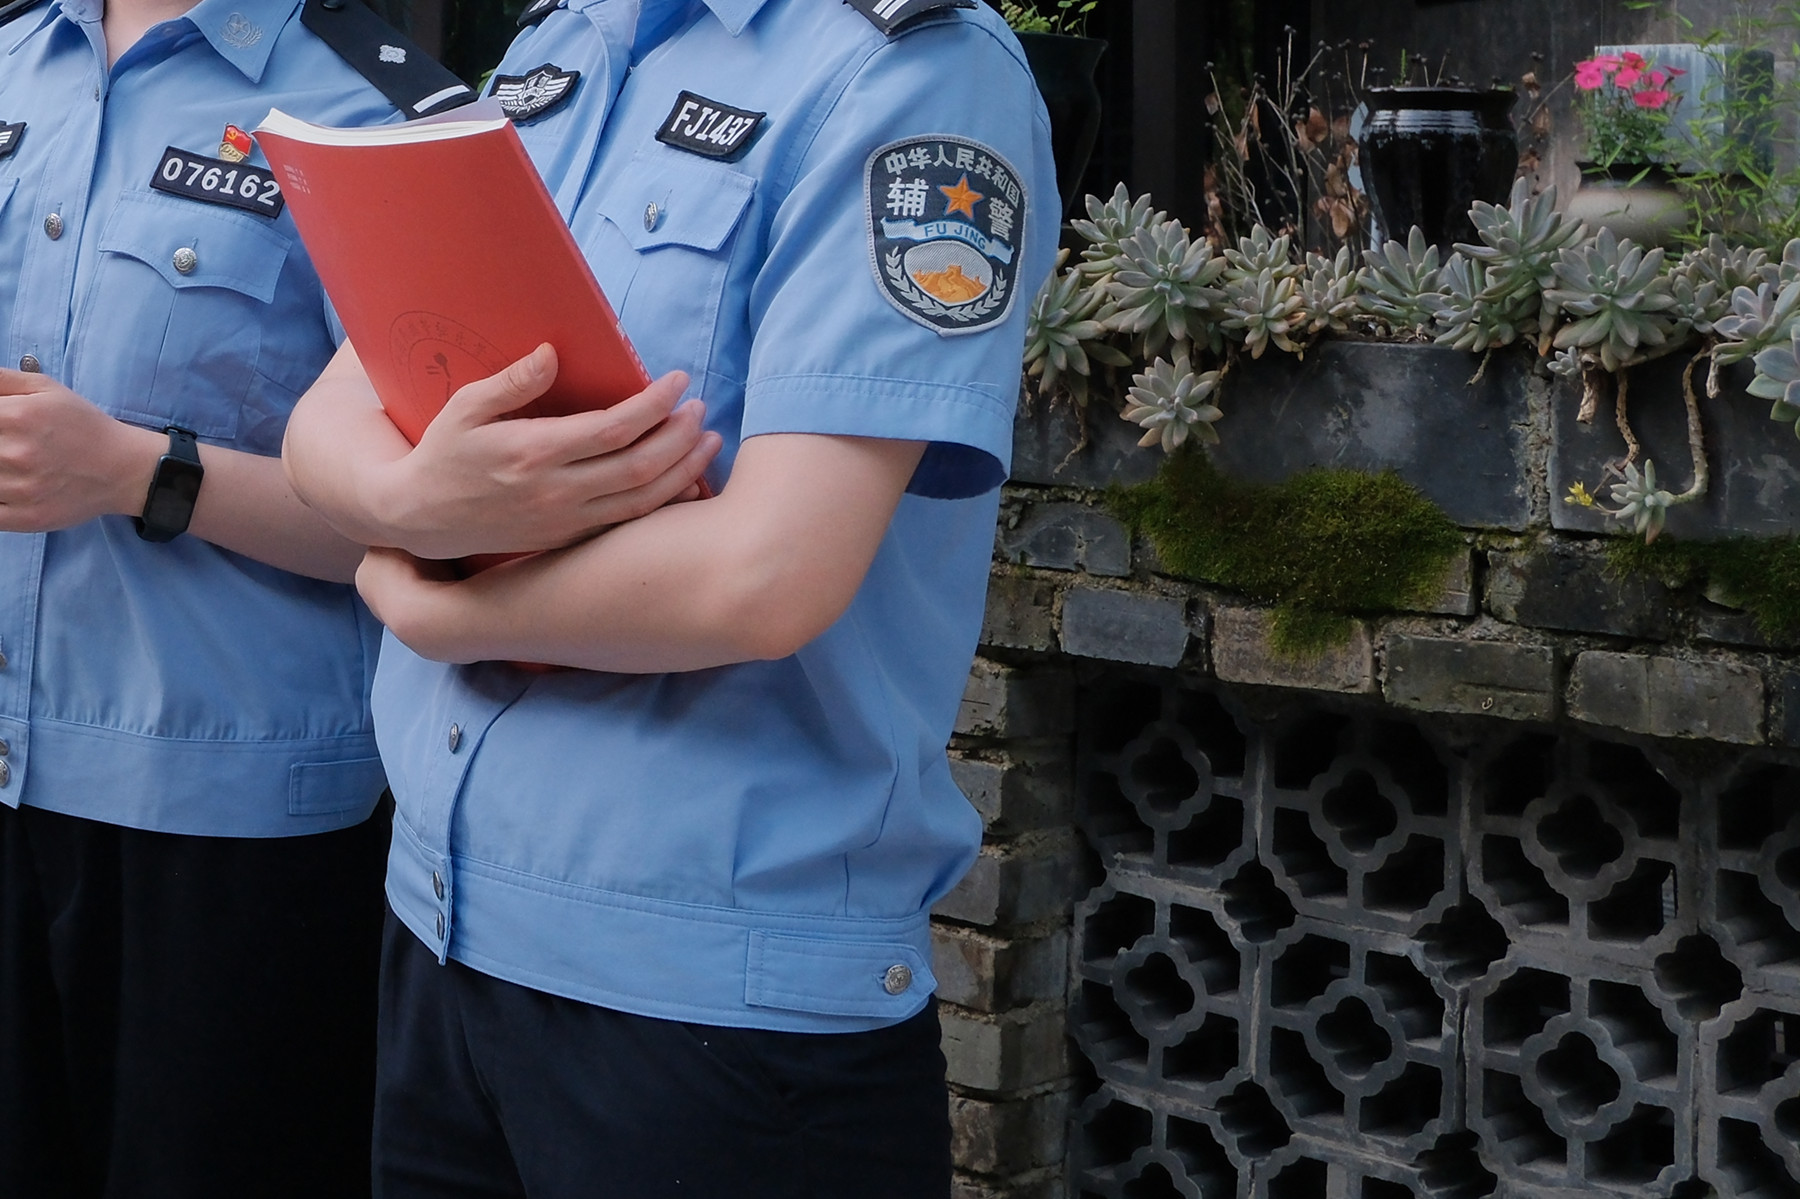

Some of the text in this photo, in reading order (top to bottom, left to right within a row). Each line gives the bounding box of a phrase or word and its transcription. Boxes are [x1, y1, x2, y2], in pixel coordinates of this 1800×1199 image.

[670, 100, 755, 147] FJ1437
[162, 156, 281, 206] 076162
[884, 144, 1020, 209] 中华人民共和国
[886, 177, 1014, 241] 辅 警
[923, 222, 987, 250] FU JING
